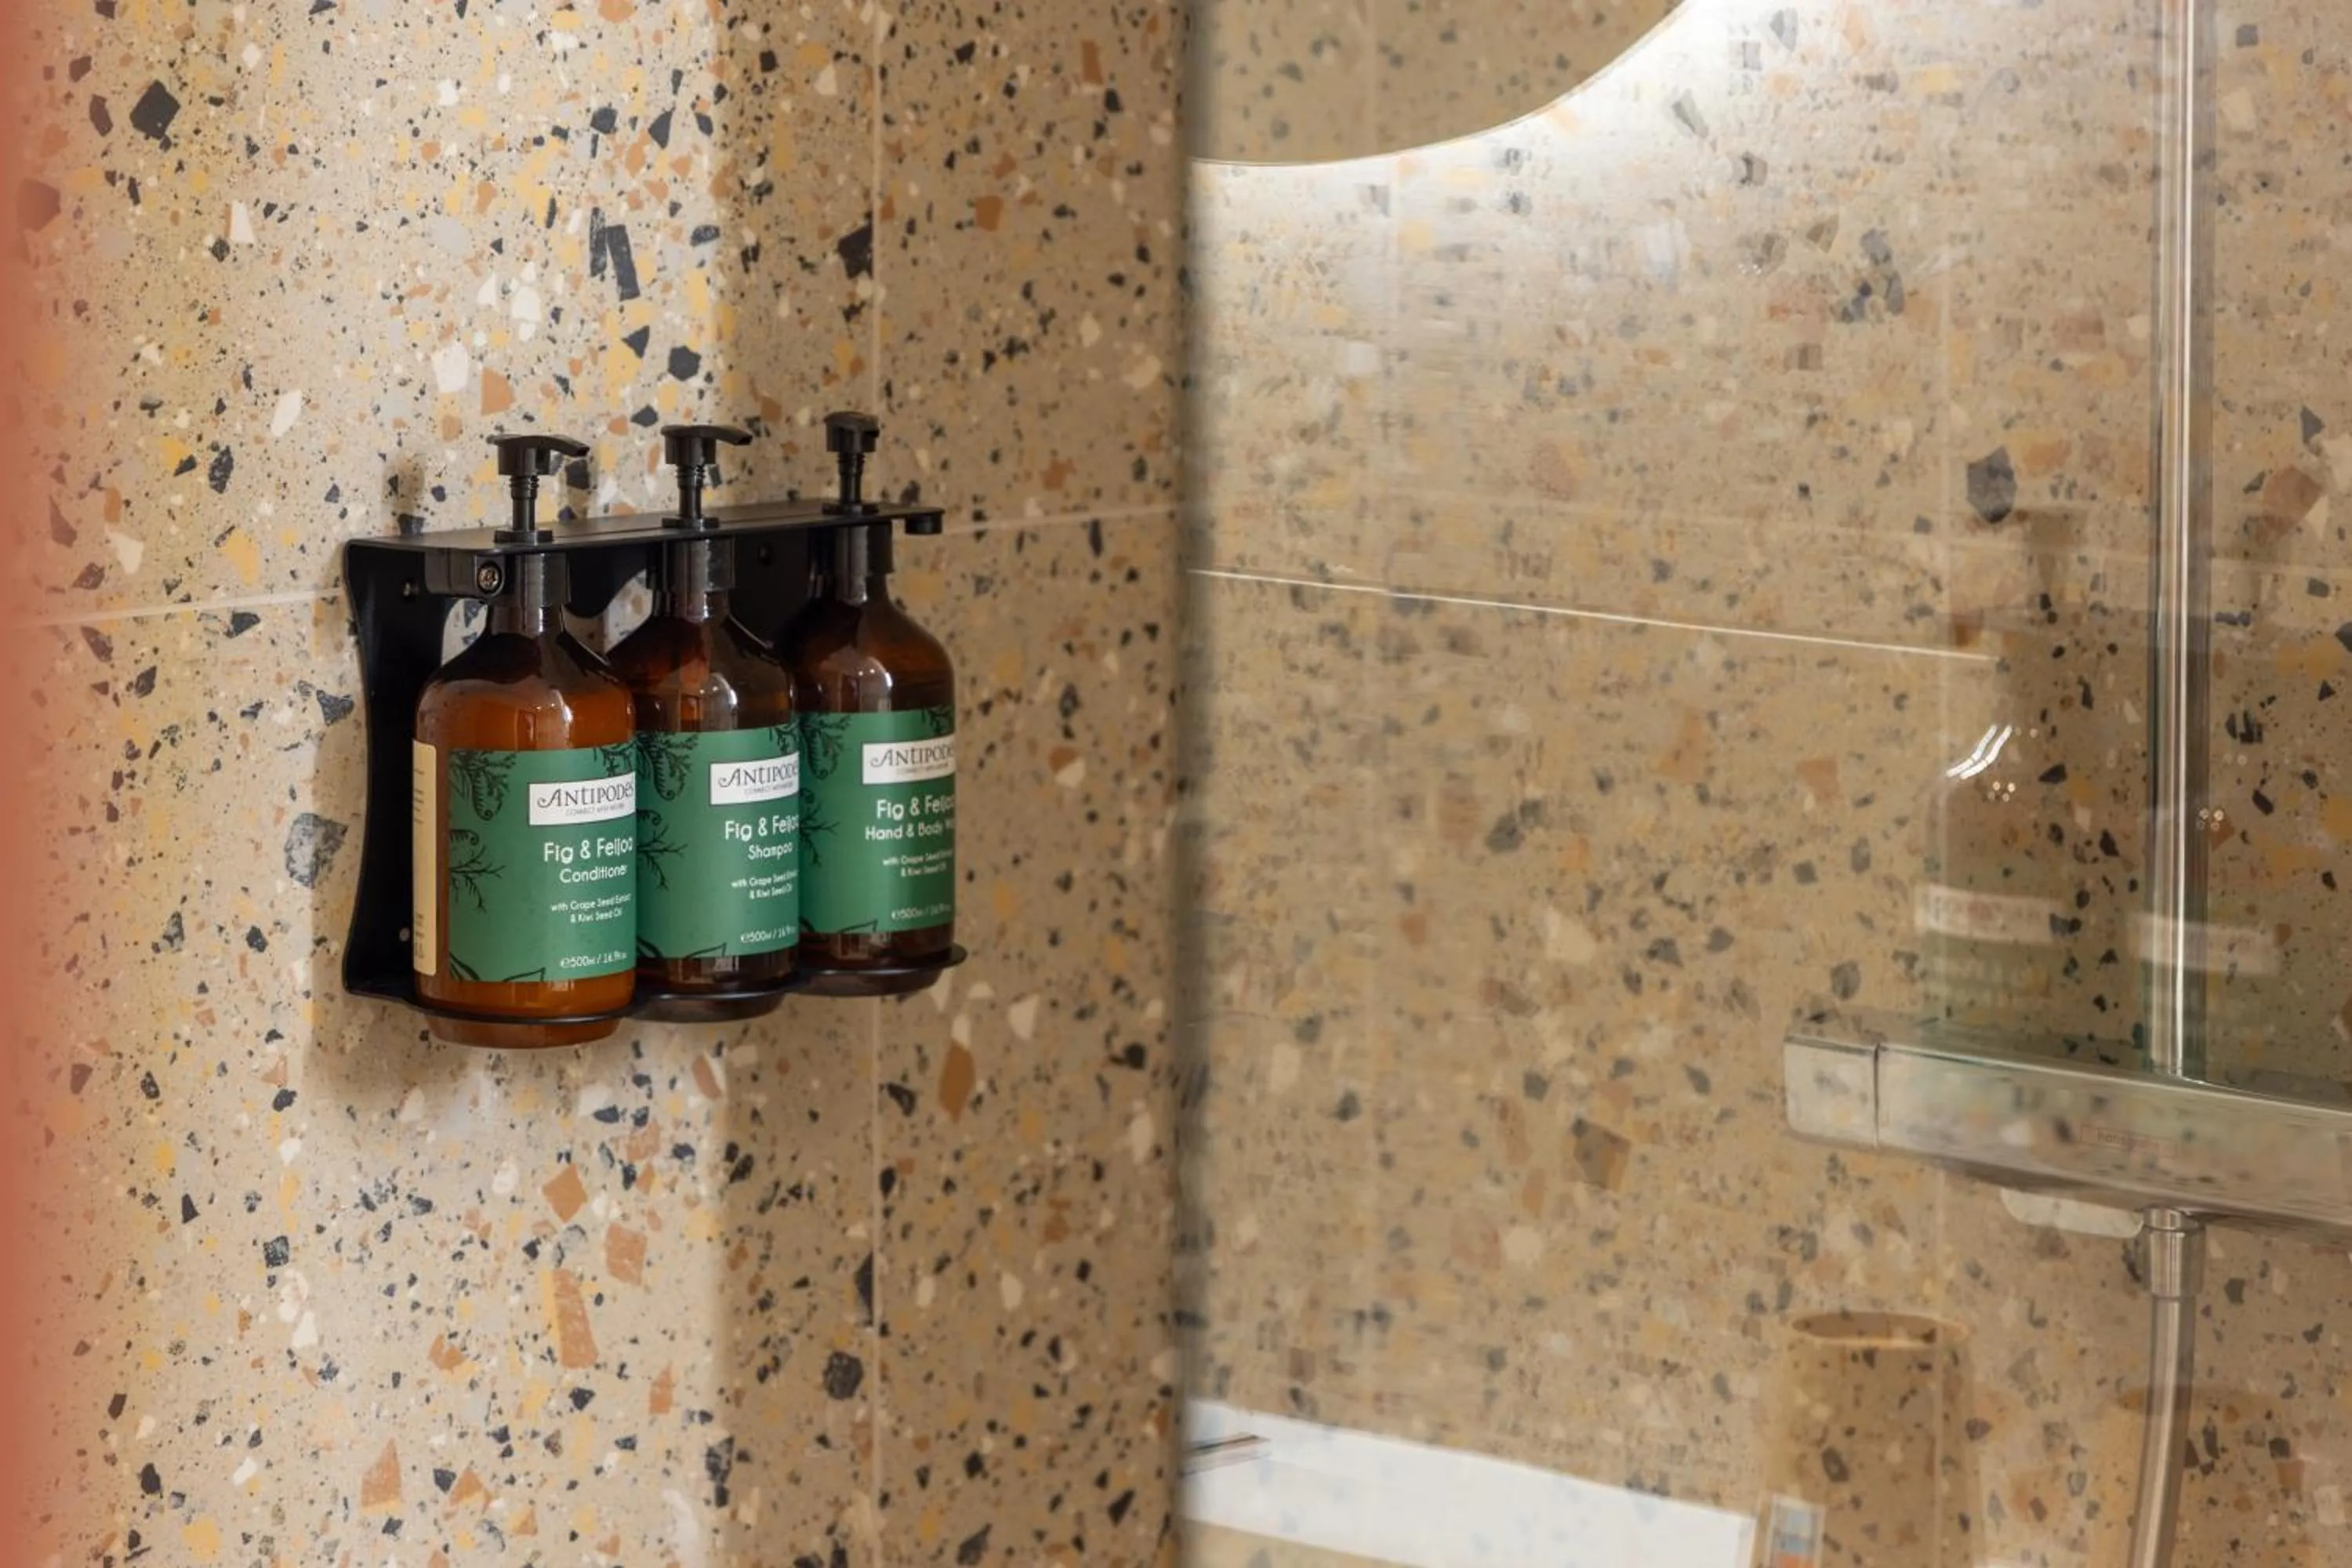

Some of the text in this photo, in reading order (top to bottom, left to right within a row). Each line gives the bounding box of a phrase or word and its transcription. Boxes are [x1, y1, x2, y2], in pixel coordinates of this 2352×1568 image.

[876, 798, 904, 821] Fig
[909, 796, 920, 816] &
[724, 820, 753, 842] Fig
[758, 817, 768, 837] &
[865, 823, 903, 841] Hand
[906, 822, 915, 838] &
[543, 842, 574, 864] Fig
[579, 840, 591, 859] &
